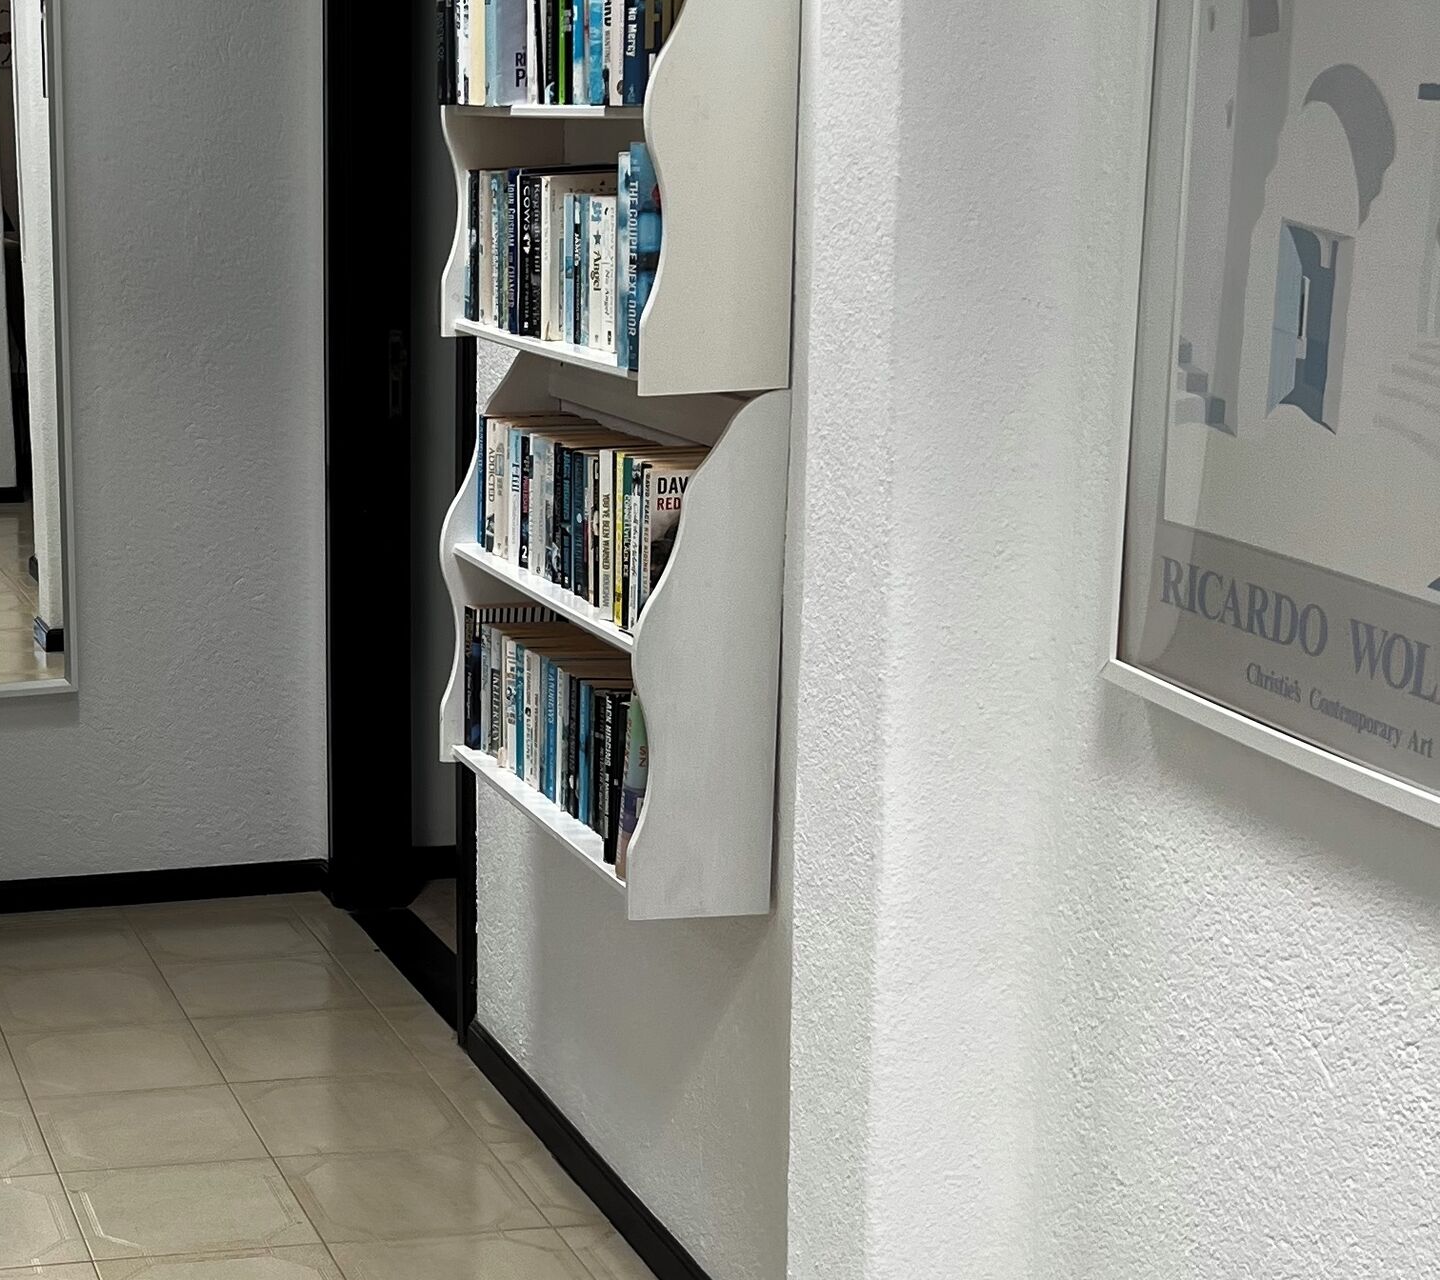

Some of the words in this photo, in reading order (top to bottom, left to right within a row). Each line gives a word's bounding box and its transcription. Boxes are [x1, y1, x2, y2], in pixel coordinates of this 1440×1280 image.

[626, 24, 637, 56] Mercy
[516, 68, 527, 87] P
[523, 185, 531, 231] COWS
[629, 180, 638, 206] THE
[629, 209, 638, 261] COUPLE
[592, 250, 602, 291] Angel
[628, 264, 637, 296] NEXT
[627, 300, 637, 336] DOOR
[488, 447, 496, 503] ADDICTED
[563, 451, 571, 478] JACK
[657, 477, 688, 494] DAV
[656, 498, 681, 510] RED
[602, 520, 611, 539] BEEN
[521, 545, 528, 559] 2
[602, 540, 611, 570] WARNED
[1160, 556, 1328, 657] RICARDO
[1349, 618, 1440, 706] WOL
[492, 677, 500, 742] KELLERMAN
[1246, 662, 1302, 703] Christie's
[1309, 686, 1402, 749] Contemporary
[1406, 728, 1434, 759] Art
